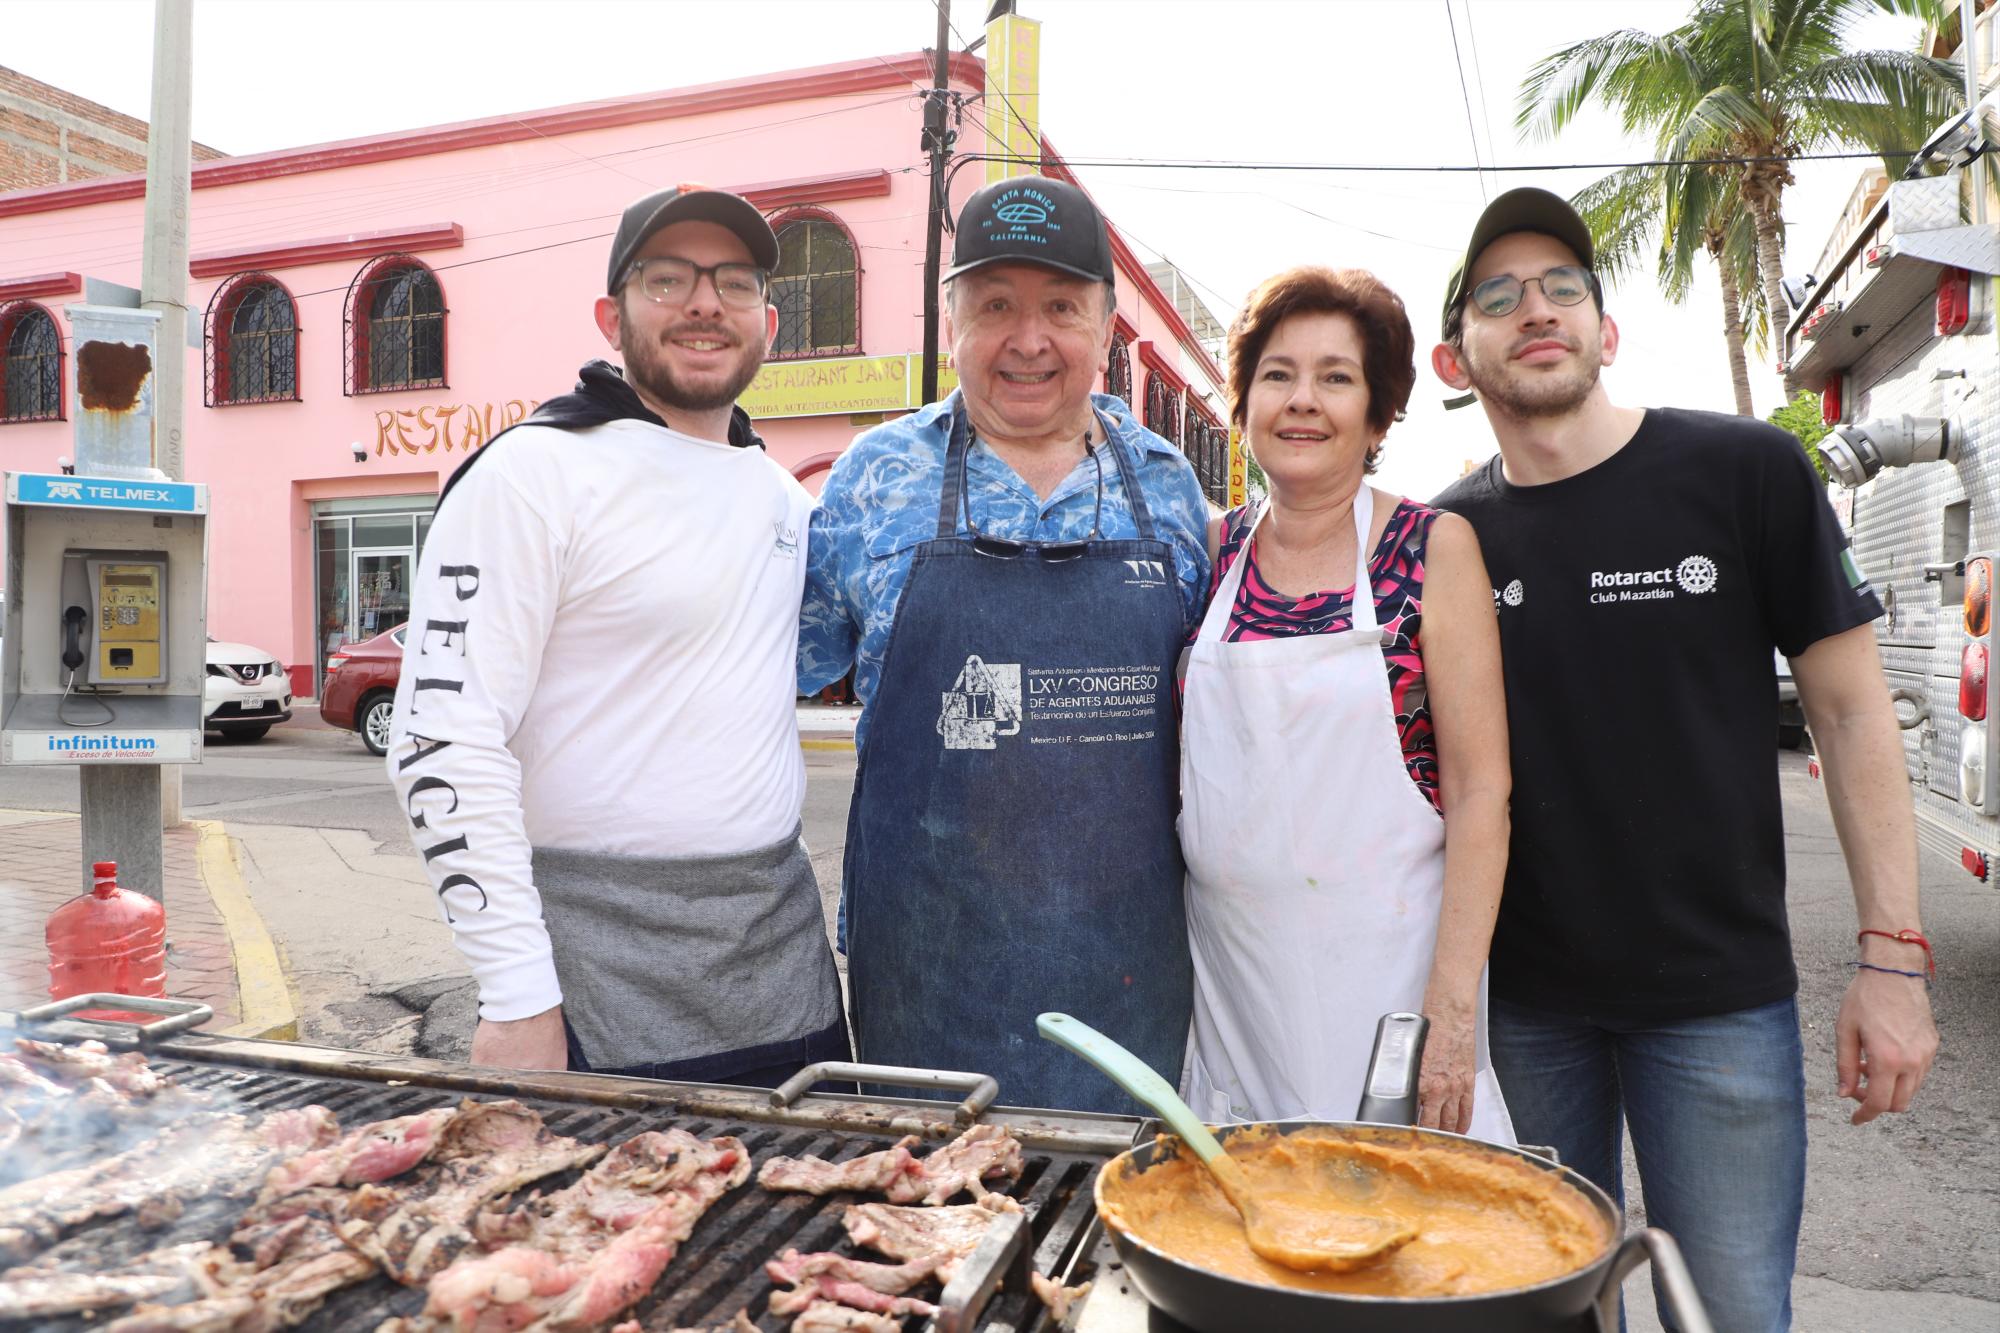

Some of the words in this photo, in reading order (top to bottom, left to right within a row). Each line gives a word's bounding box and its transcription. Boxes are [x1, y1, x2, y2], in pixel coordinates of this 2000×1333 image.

[991, 189, 1019, 210] SANTA
[1023, 188, 1056, 213] MONICA
[990, 233, 1047, 244] CALIFORNIA
[747, 365, 849, 392] ESTAURANT
[374, 400, 540, 458] RESTAUR
[87, 486, 170, 502] TELMEX
[1591, 568, 1673, 588] Rotaract
[1590, 592, 1617, 604] Club
[1620, 588, 1674, 601] Mazatlán
[1029, 678, 1063, 694] LXV
[1067, 674, 1158, 693] CONGRESO
[1030, 698, 1046, 709] DE
[1048, 696, 1101, 708] AGENTES
[1103, 693, 1156, 706] ADUANALES
[1030, 710, 1074, 720] Testimonio
[1099, 708, 1131, 718] Esfuerzo
[49, 735, 156, 751] infinitum
[399, 563, 487, 923] PELAGIC
[1079, 733, 1105, 743] Cancún
[1115, 733, 1128, 741] Roo
[69, 750, 100, 759] Exceso
[115, 749, 154, 758] Velocidad
